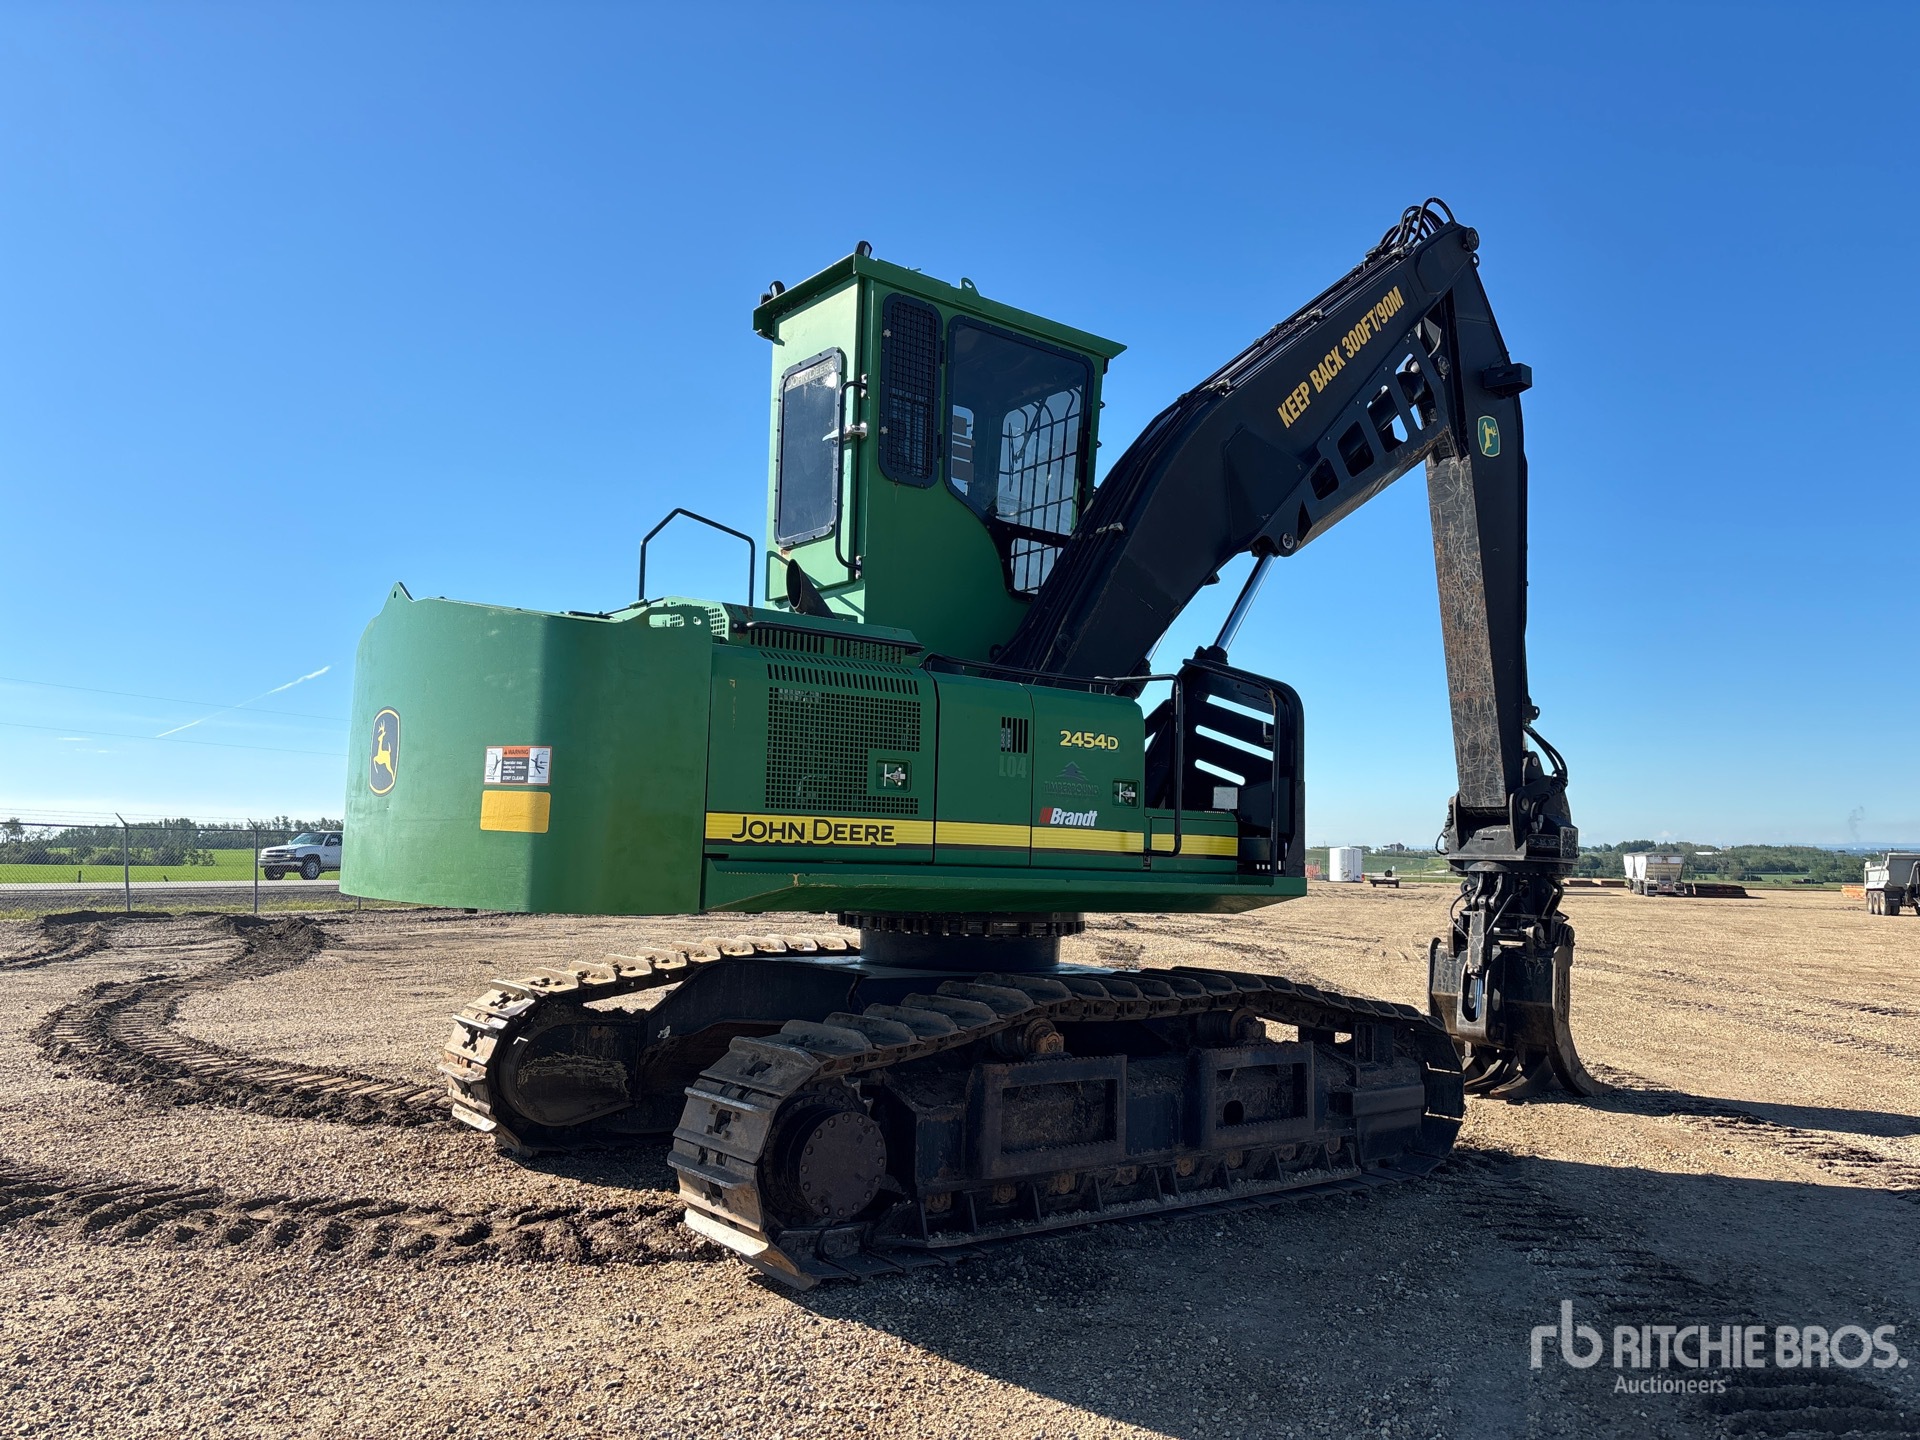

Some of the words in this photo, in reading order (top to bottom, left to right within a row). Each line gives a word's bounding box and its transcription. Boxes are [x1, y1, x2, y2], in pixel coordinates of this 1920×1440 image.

[1277, 381, 1311, 429] KEEP
[1309, 345, 1346, 393] BACK
[1341, 286, 1405, 358] 300FT/90M
[1060, 730, 1119, 750] 2454D
[1050, 807, 1098, 827] Brandt
[732, 816, 805, 841] JOHN
[813, 819, 895, 843] DEERE
